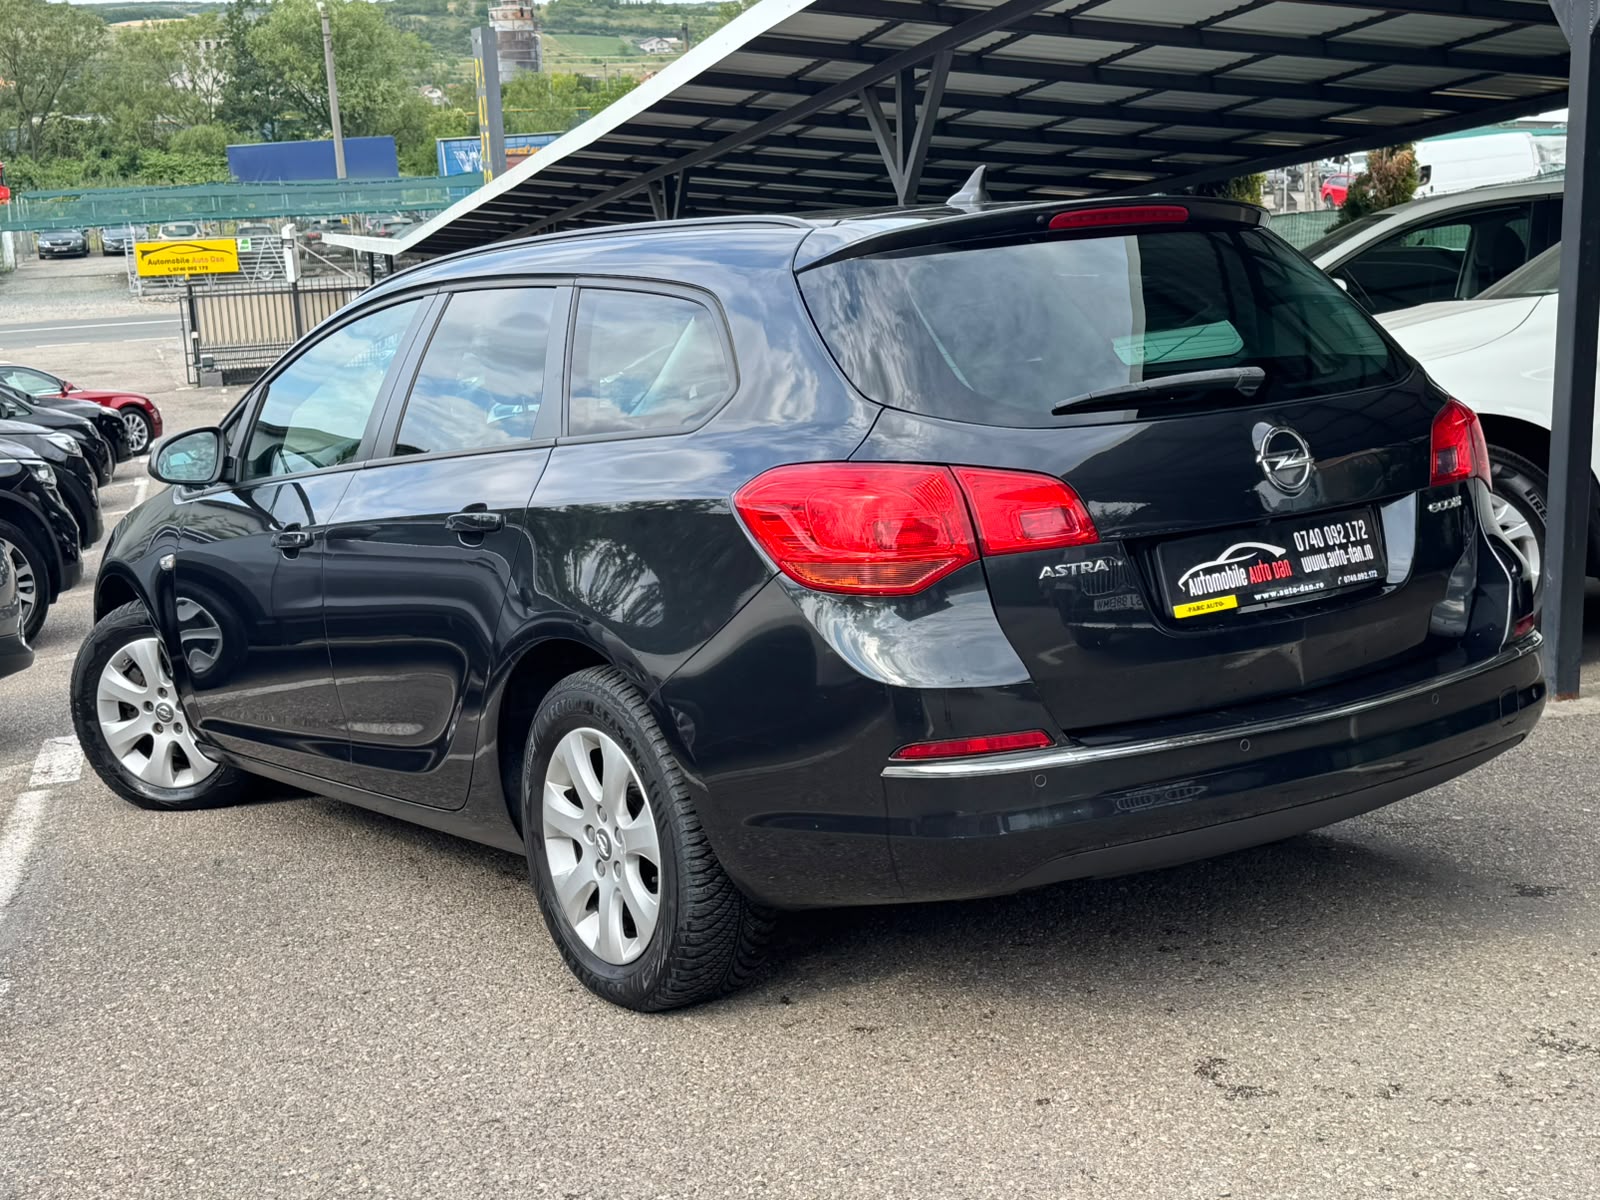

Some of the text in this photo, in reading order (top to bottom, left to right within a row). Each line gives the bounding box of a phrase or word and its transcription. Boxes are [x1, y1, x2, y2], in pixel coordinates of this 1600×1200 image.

[147, 257, 190, 266] Automobile
[192, 256, 209, 264] Auto
[1293, 519, 1369, 553] 0740 092 172
[1300, 543, 1375, 574] www.auto-dan.ro
[1038, 559, 1110, 580] ASTRA
[1253, 582, 1325, 601] www.auto-dan.ro
